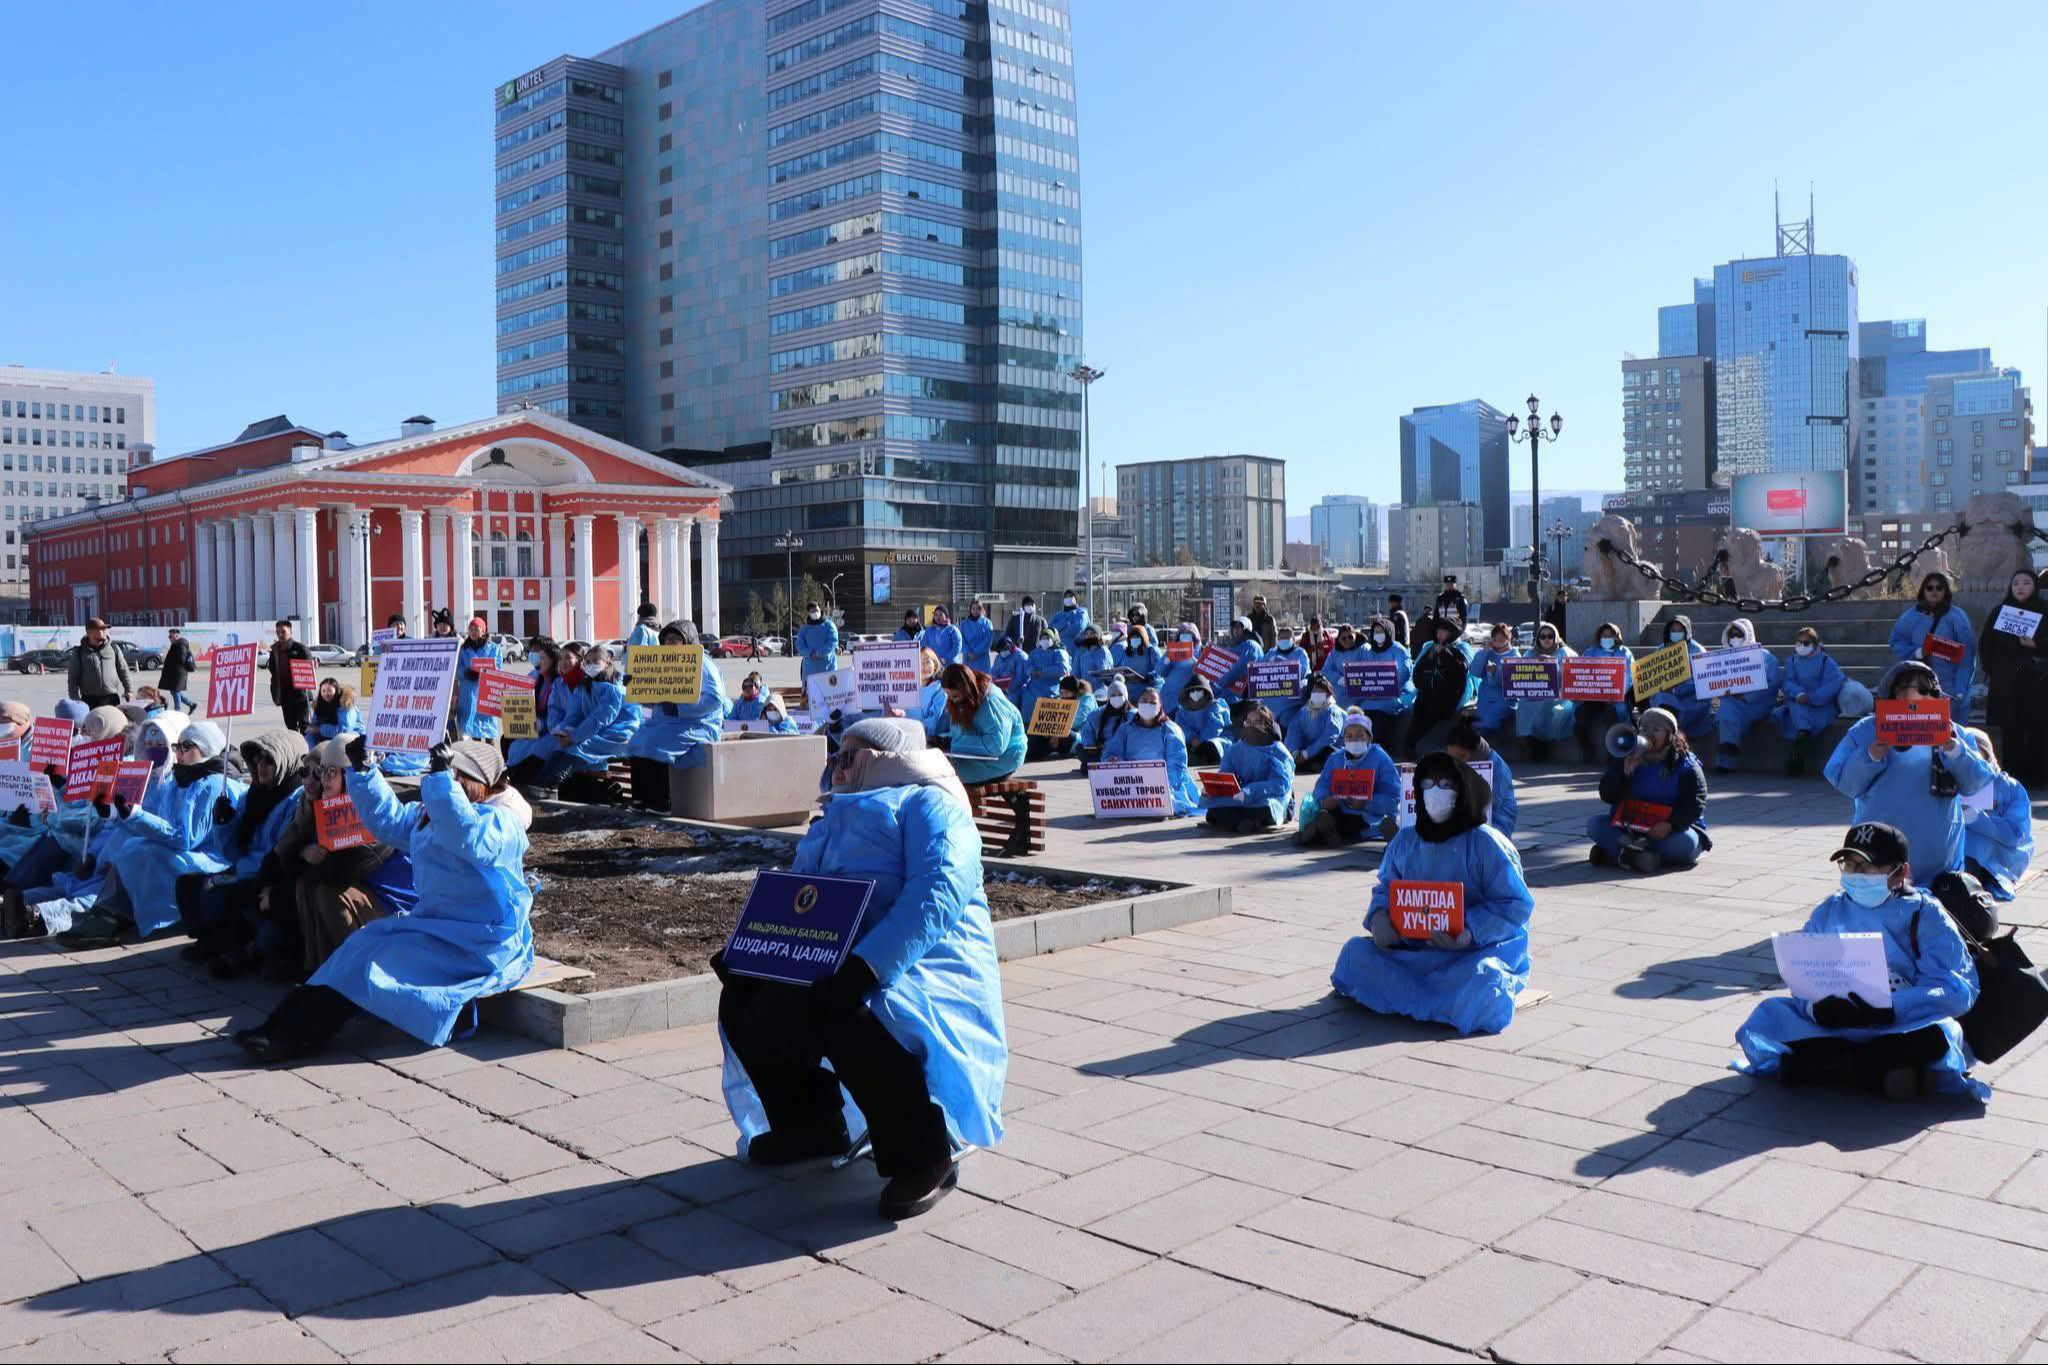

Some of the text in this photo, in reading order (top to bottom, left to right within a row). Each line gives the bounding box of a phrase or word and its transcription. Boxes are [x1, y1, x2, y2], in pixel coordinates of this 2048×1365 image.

[516, 71, 543, 92] UNITEL
[818, 554, 855, 563] BREITLING
[896, 553, 937, 562] BREITLING
[2002, 622, 2028, 636] ЗАСЬЯ
[217, 648, 251, 665] СУВИЛАГЧ
[634, 652, 697, 664] АЖИЛ ХИЙГЭЭД
[1636, 646, 1683, 674] АЖИЛЛАСААР
[215, 664, 234, 678] РОБОТ
[384, 657, 450, 673] ЭМЧ АЖИЛТНУУДЫН
[894, 659, 911, 669] ЭРҮҮЛ
[1637, 656, 1684, 682] ЯДУУРСААР
[1706, 659, 1722, 670] ЭРҮҮЛ
[631, 676, 695, 685] ТӨРИЙН БОДЛОГЫГ
[859, 671, 916, 681] МЭНДИЙН ТУСЛАМЖ
[1638, 667, 1686, 695] ЦӨХӨРСӨӨР
[386, 676, 411, 691] ҮНДСЭН
[413, 677, 440, 691] ЦАЛИНГ
[857, 683, 890, 693] ҮЙЛЧИЛГЭЭ
[212, 677, 249, 713] ХҮН
[672, 687, 694, 695] БАЙНА
[396, 696, 410, 710] САЯ
[411, 696, 435, 711] ТӨГРӨГ
[1061, 703, 1072, 711] ARE
[375, 713, 437, 731] БОЛГОН НЭМЭХИЙГ
[1038, 710, 1069, 723] WORTH
[1033, 722, 1065, 735] MORE!!!
[372, 731, 405, 748] ШААРДАЖ
[73, 746, 104, 759] СУВИЛАГЧ
[105, 742, 121, 752] НАРТ
[20, 783, 33, 791] ТӨС
[1114, 775, 1144, 785] АЖЛЫН
[1096, 786, 1165, 797] ХУВЦСЫГ ТӨРӨӨС
[326, 806, 355, 825] ЭРҮҮ
[1396, 888, 1456, 910] ХАМТДАА
[747, 921, 839, 942] АМЬДРАЛЫН БАТАЛГАА
[733, 936, 838, 964] ШУДАРГА ЦАЛИН
